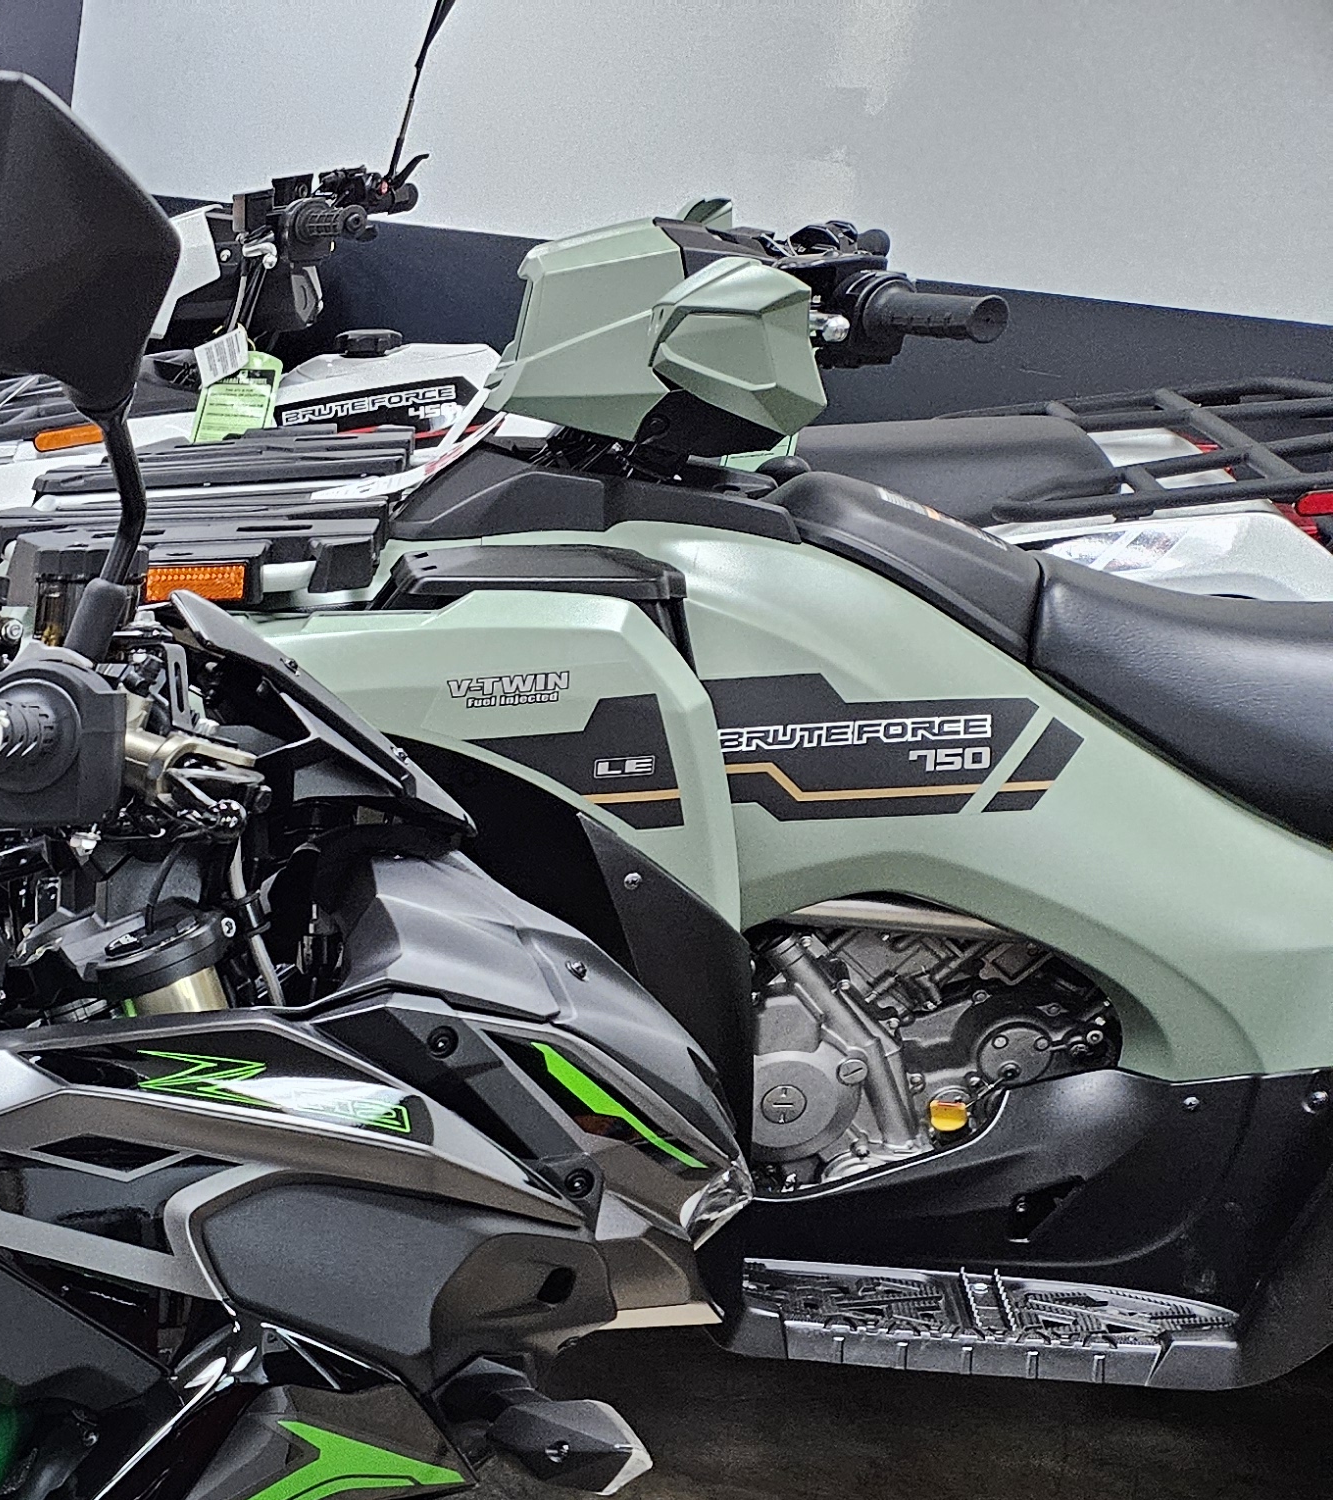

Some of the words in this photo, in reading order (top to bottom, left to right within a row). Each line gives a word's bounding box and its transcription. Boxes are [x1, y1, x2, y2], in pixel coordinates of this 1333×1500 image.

[447, 671, 570, 698] V-TWIN
[466, 692, 498, 708] Fuel
[500, 690, 559, 706] Injected
[597, 758, 653, 778] LE
[908, 746, 991, 772] 750
